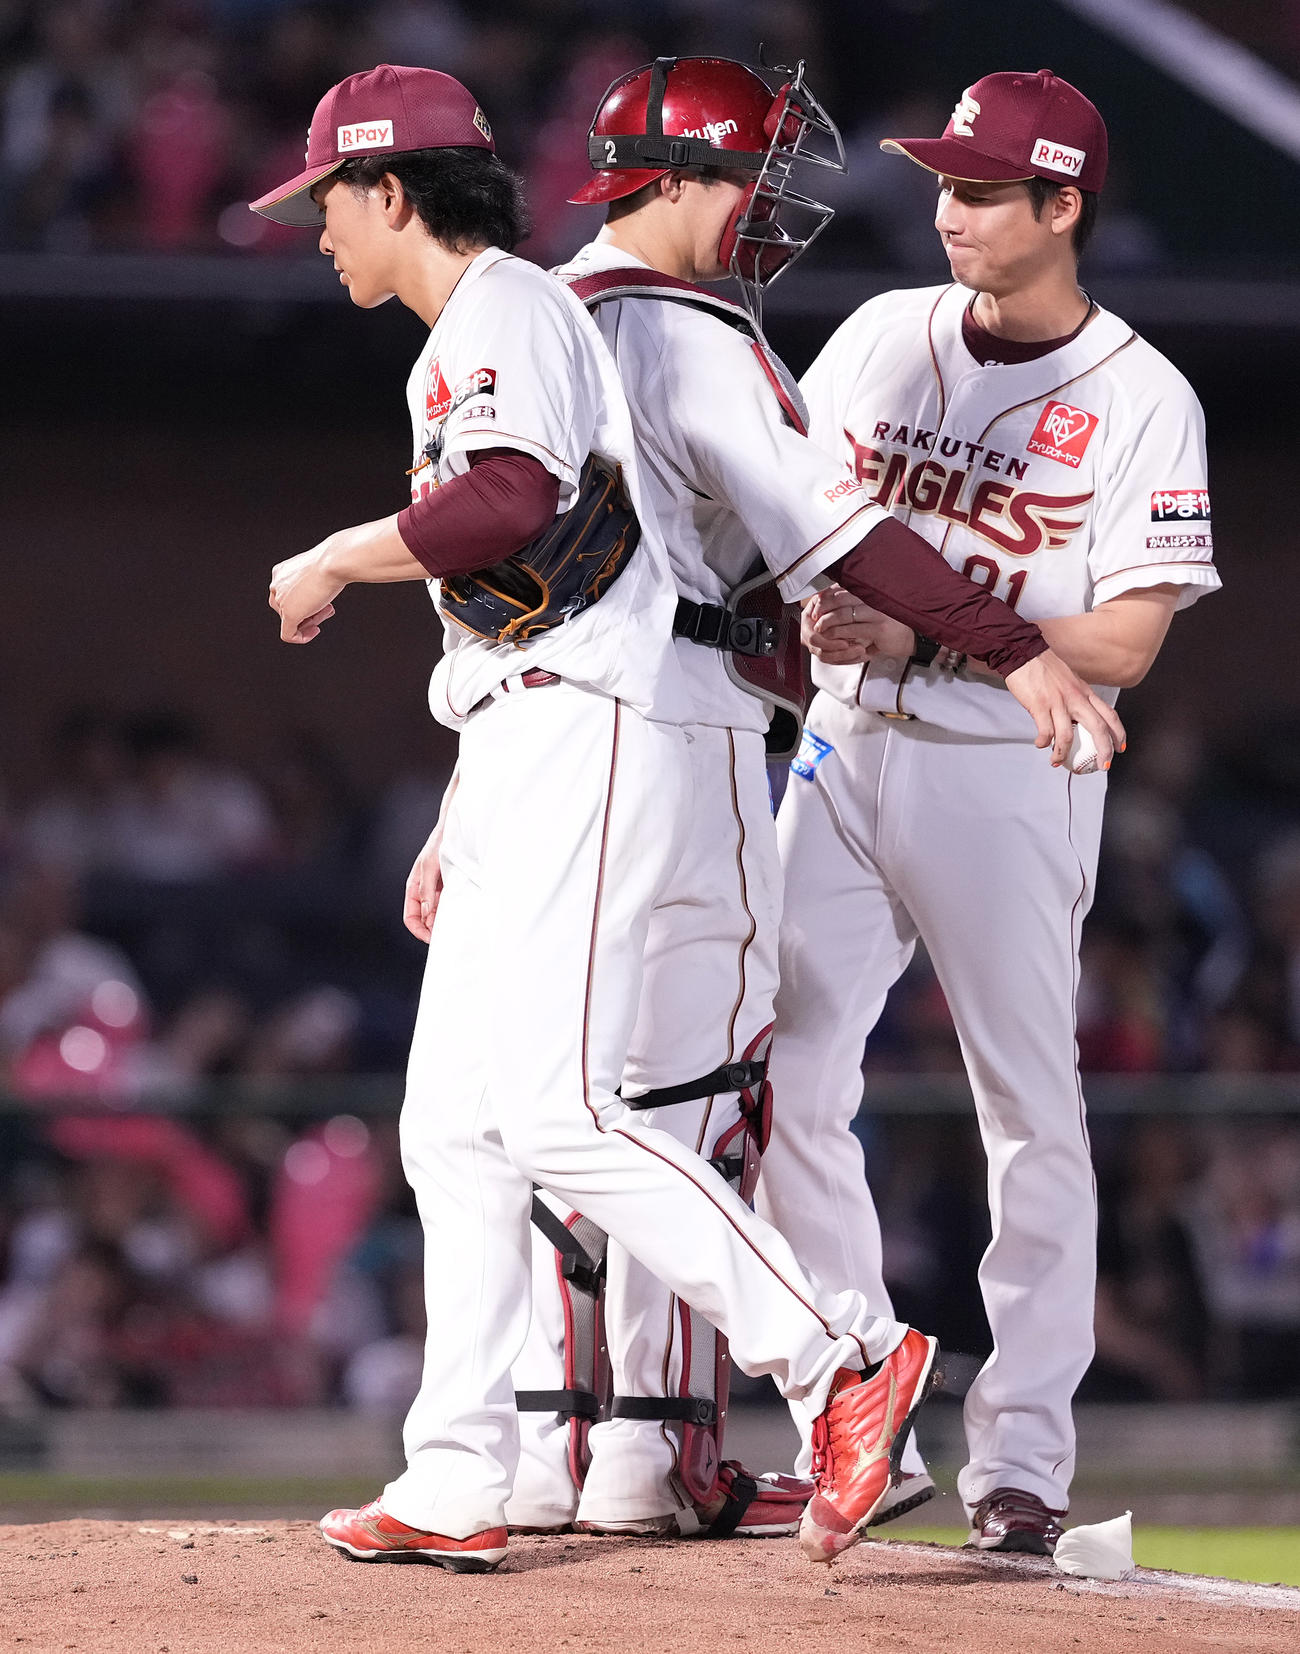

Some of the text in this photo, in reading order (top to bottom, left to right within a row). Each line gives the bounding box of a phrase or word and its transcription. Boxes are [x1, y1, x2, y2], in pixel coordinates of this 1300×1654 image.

[356, 127, 389, 143] Pay
[677, 119, 739, 141] kuten
[604, 140, 618, 163] 2
[1052, 150, 1082, 172] Pay
[872, 420, 1030, 481] RAKUTEN
[1028, 440, 1081, 466] アイリスオーヤマ
[843, 427, 1095, 558] EAGLES
